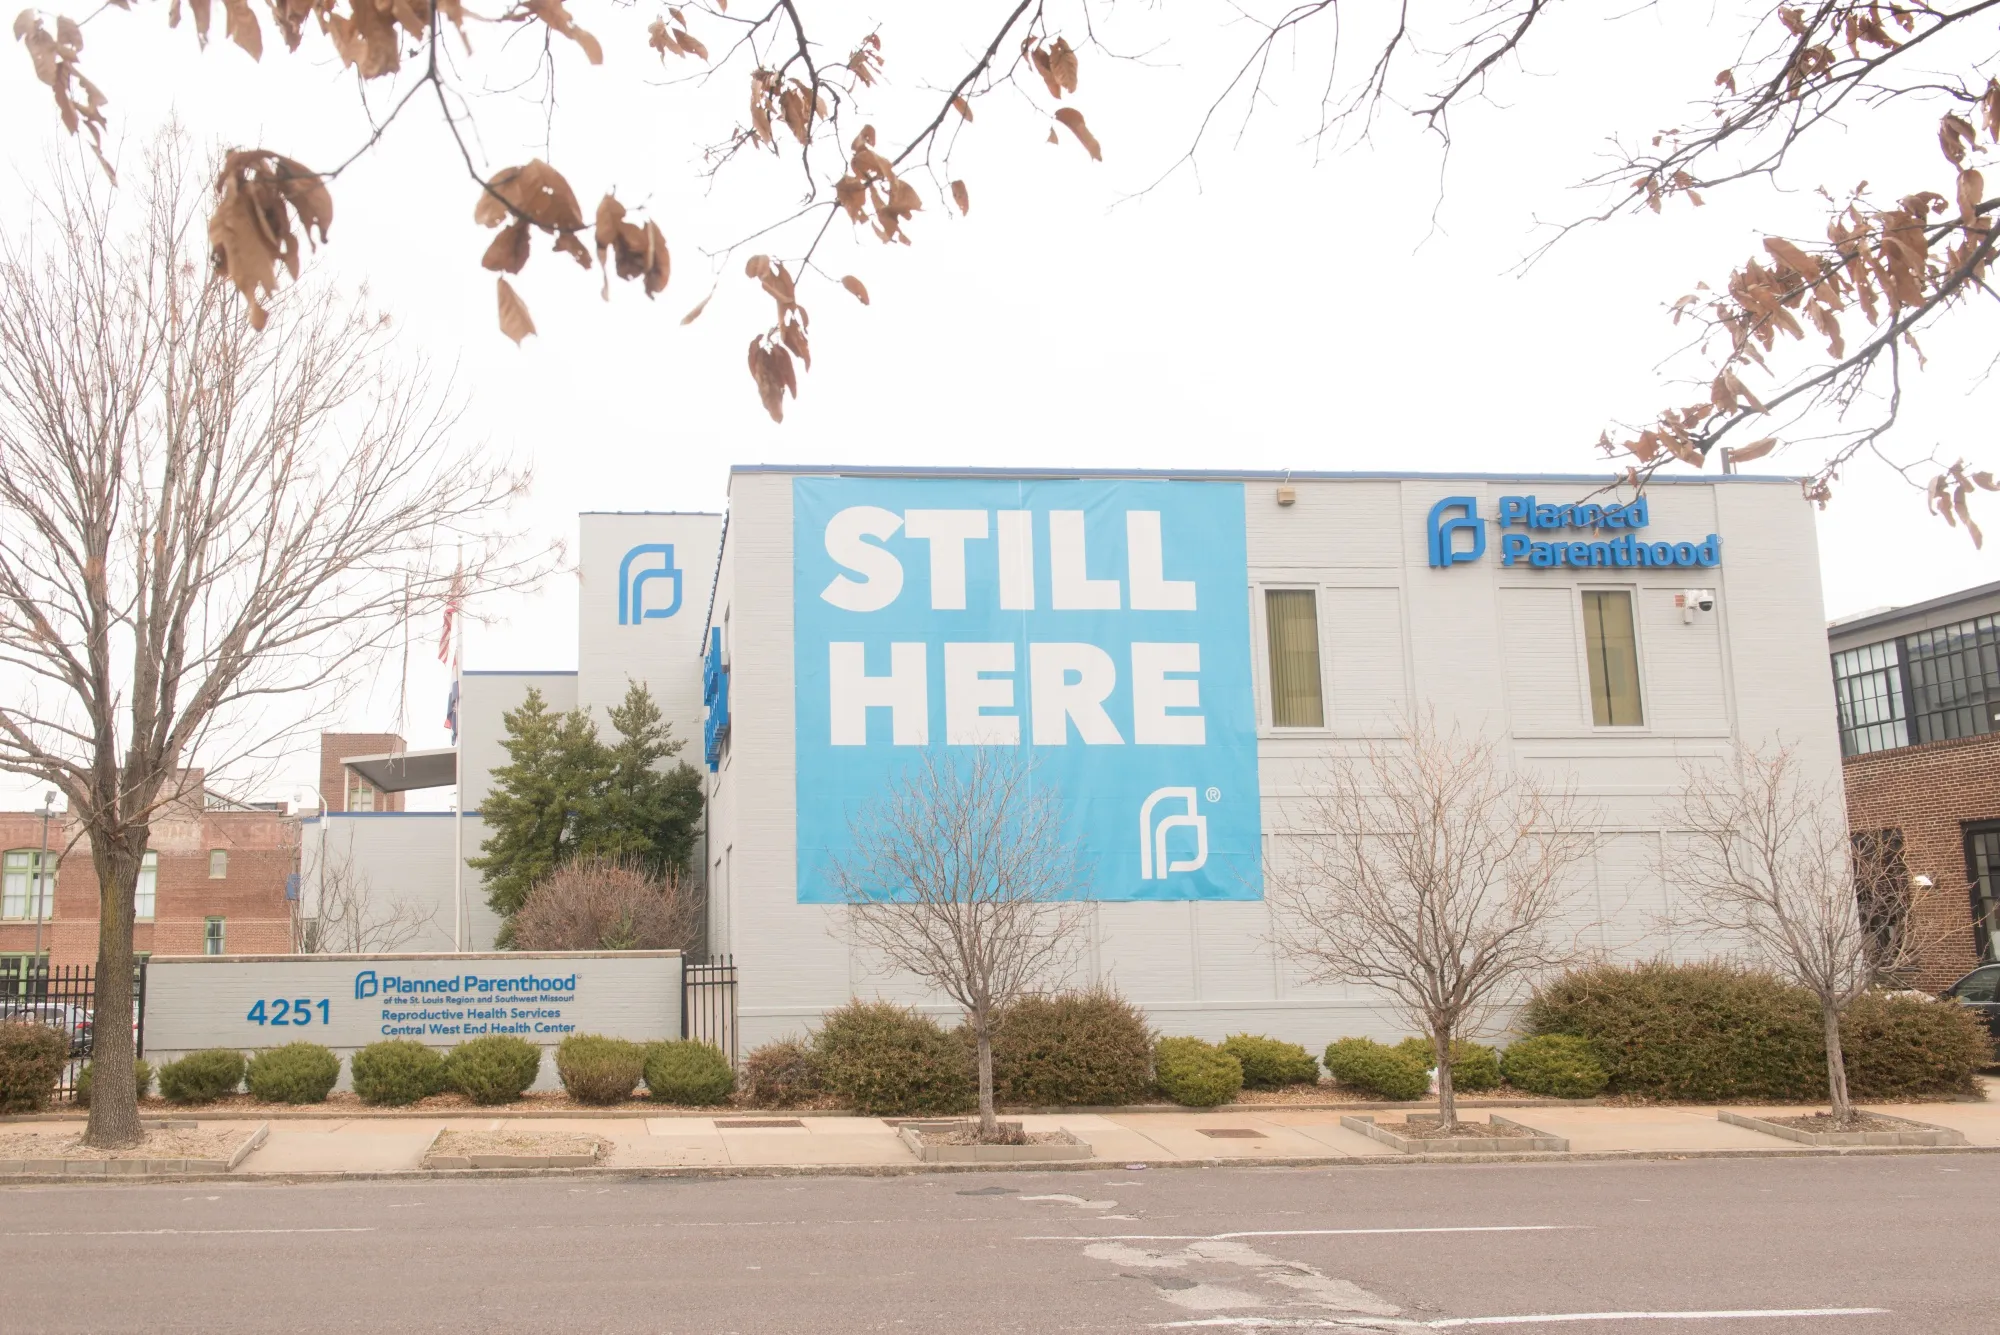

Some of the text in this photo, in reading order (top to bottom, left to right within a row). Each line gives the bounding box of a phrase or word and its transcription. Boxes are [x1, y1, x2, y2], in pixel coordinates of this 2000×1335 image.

[1499, 494, 1649, 528] Planned
[820, 505, 1197, 612] STILL
[1502, 533, 1720, 567] Parenthood
[829, 642, 1206, 746] HERE
[382, 973, 576, 993] Planned Parenthood
[246, 998, 330, 1026] 4251
[383, 996, 394, 1005] of
[394, 996, 408, 1005] the
[422, 995, 444, 1004] Louis
[446, 995, 475, 1005] Region
[477, 994, 493, 1003] and
[495, 994, 538, 1003] Southwest
[540, 994, 575, 1002] Missouri
[381, 1007, 561, 1023] Reproductive Health Services
[381, 1021, 576, 1035] Central West End Health Center
